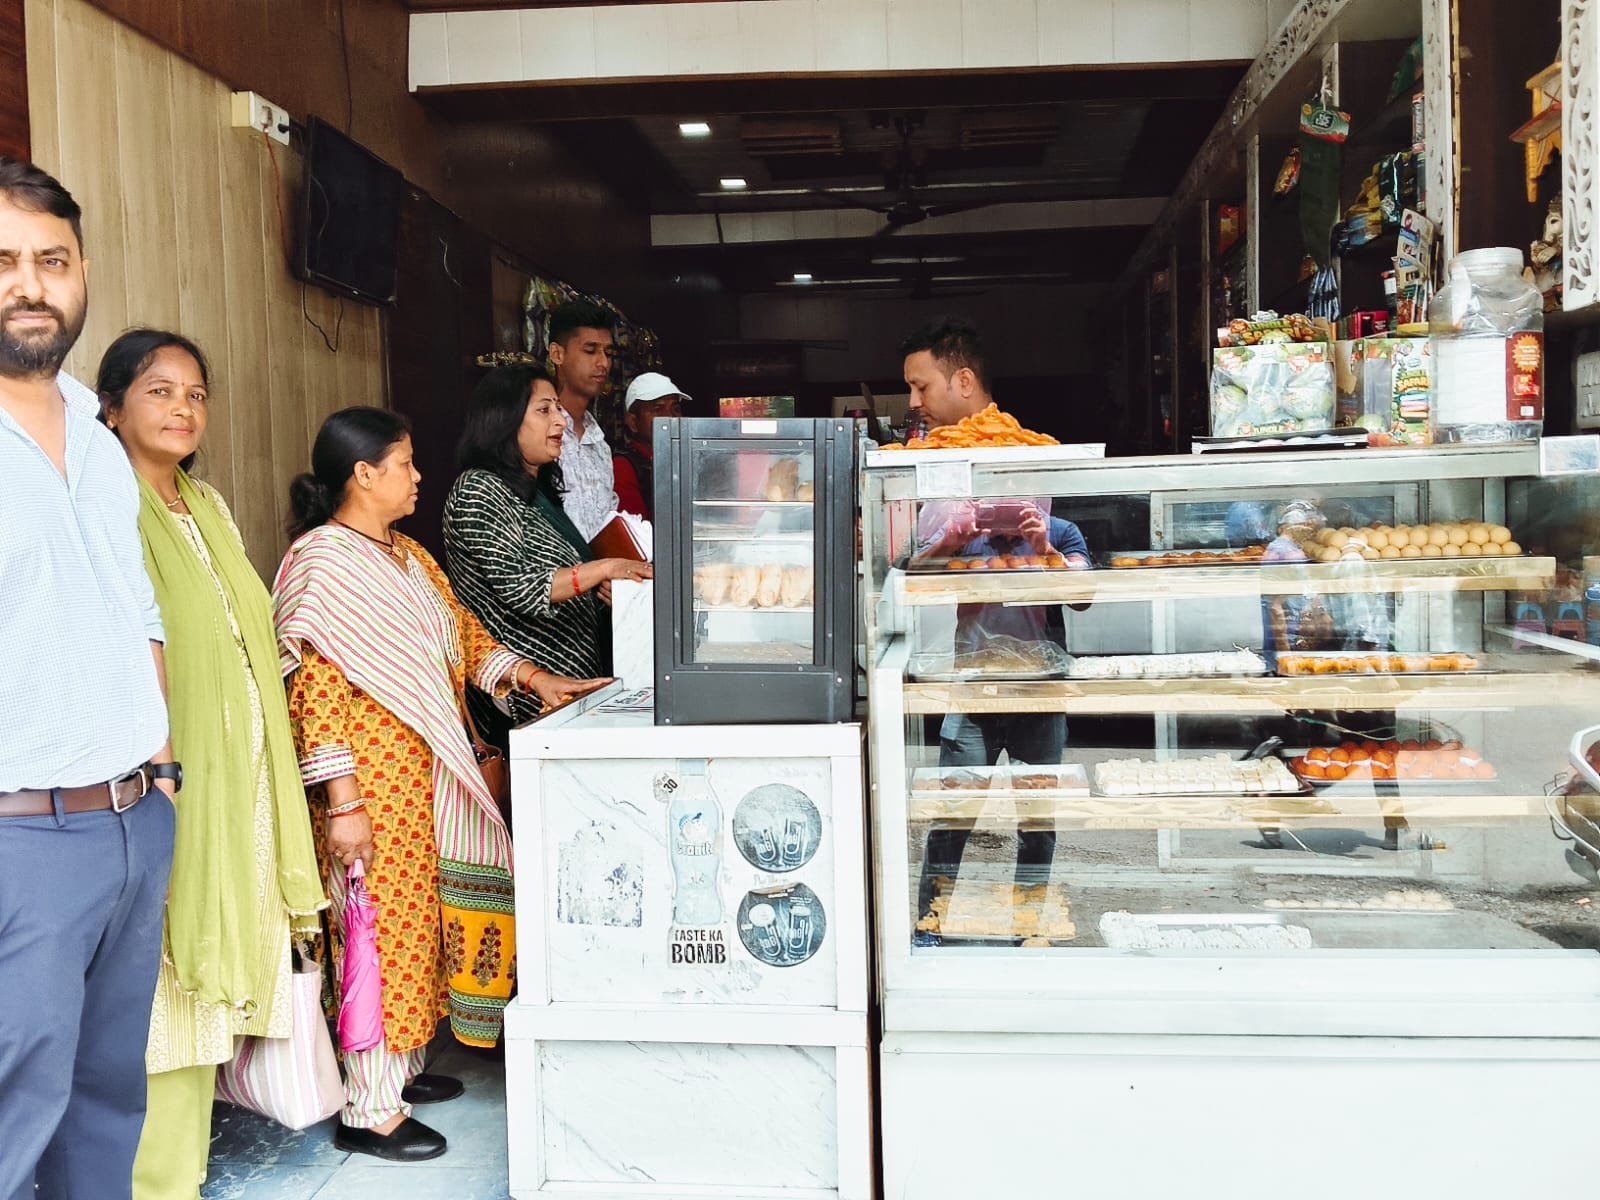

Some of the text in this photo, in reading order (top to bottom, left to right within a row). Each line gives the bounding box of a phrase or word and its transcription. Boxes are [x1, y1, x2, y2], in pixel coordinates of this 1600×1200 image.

[663, 778, 678, 793] 30
[675, 929, 723, 941] TASTE KA
[671, 943, 727, 964] BOMB
